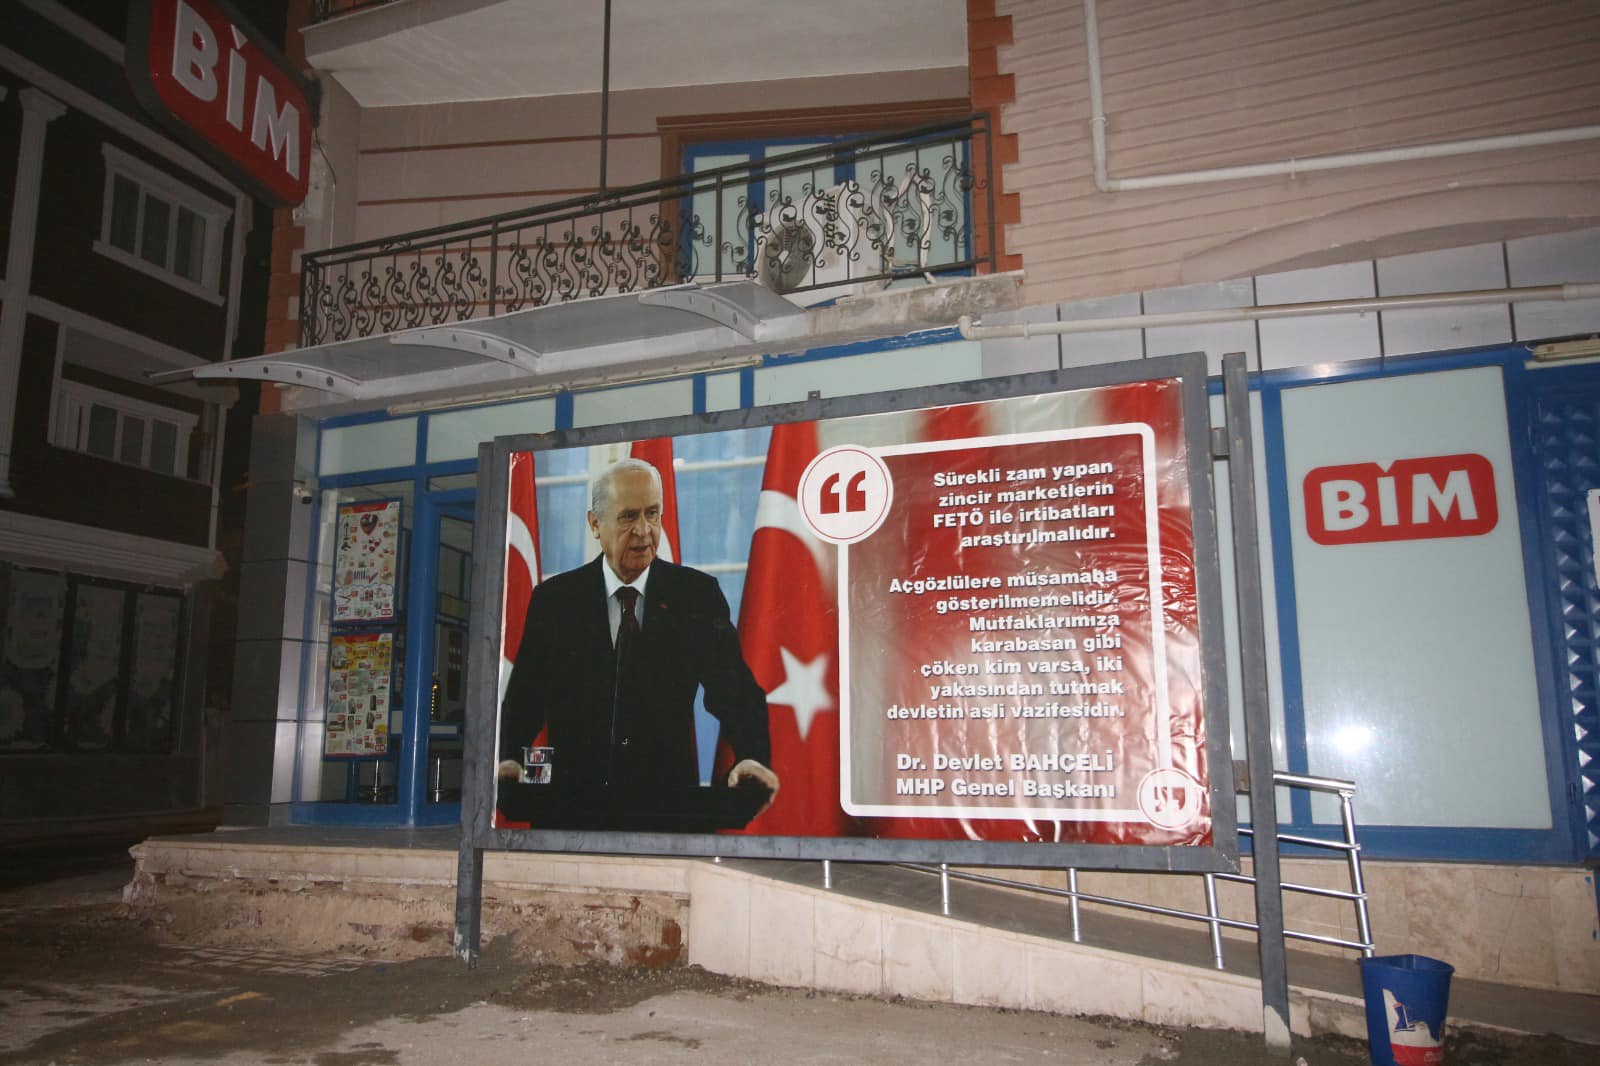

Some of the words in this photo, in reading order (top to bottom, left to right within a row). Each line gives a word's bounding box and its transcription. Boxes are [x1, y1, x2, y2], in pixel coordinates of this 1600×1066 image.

[172, 0, 300, 181] BİM
[933, 468, 1001, 488] Sürekli
[1006, 468, 1046, 481] zam
[1052, 462, 1113, 481] yapan
[938, 490, 992, 507] zincir
[997, 481, 1114, 503] marketlerin
[933, 507, 984, 528] FETÖ
[989, 510, 1014, 525] ile
[1019, 504, 1115, 523] irtibatları
[961, 524, 1116, 548] araştırılmalıdır.
[889, 574, 1002, 595] Açgözlülere
[1007, 568, 1118, 587] müsamaha
[936, 590, 1119, 614] gösterilmemelidir.
[969, 615, 1121, 632] Mutfaklarımıza
[971, 637, 1077, 653] karabasan
[1083, 634, 1121, 652] gibi
[920, 659, 979, 677] çöken
[985, 658, 1022, 673] kim
[1028, 658, 1091, 675] varsa,
[1096, 656, 1123, 672] iki
[930, 681, 1044, 700] yakasından
[1049, 679, 1124, 695] tutmak
[887, 704, 964, 719] devletin
[968, 704, 1005, 719] asli
[1011, 702, 1125, 718] vazifesidir.
[897, 754, 926, 770] Dr.
[933, 754, 1003, 770] Devlet
[1010, 750, 1113, 773] BAHÇELİ
[896, 778, 945, 795] MHP
[951, 780, 1015, 796] Genel
[1022, 780, 1115, 799] Başkanı
